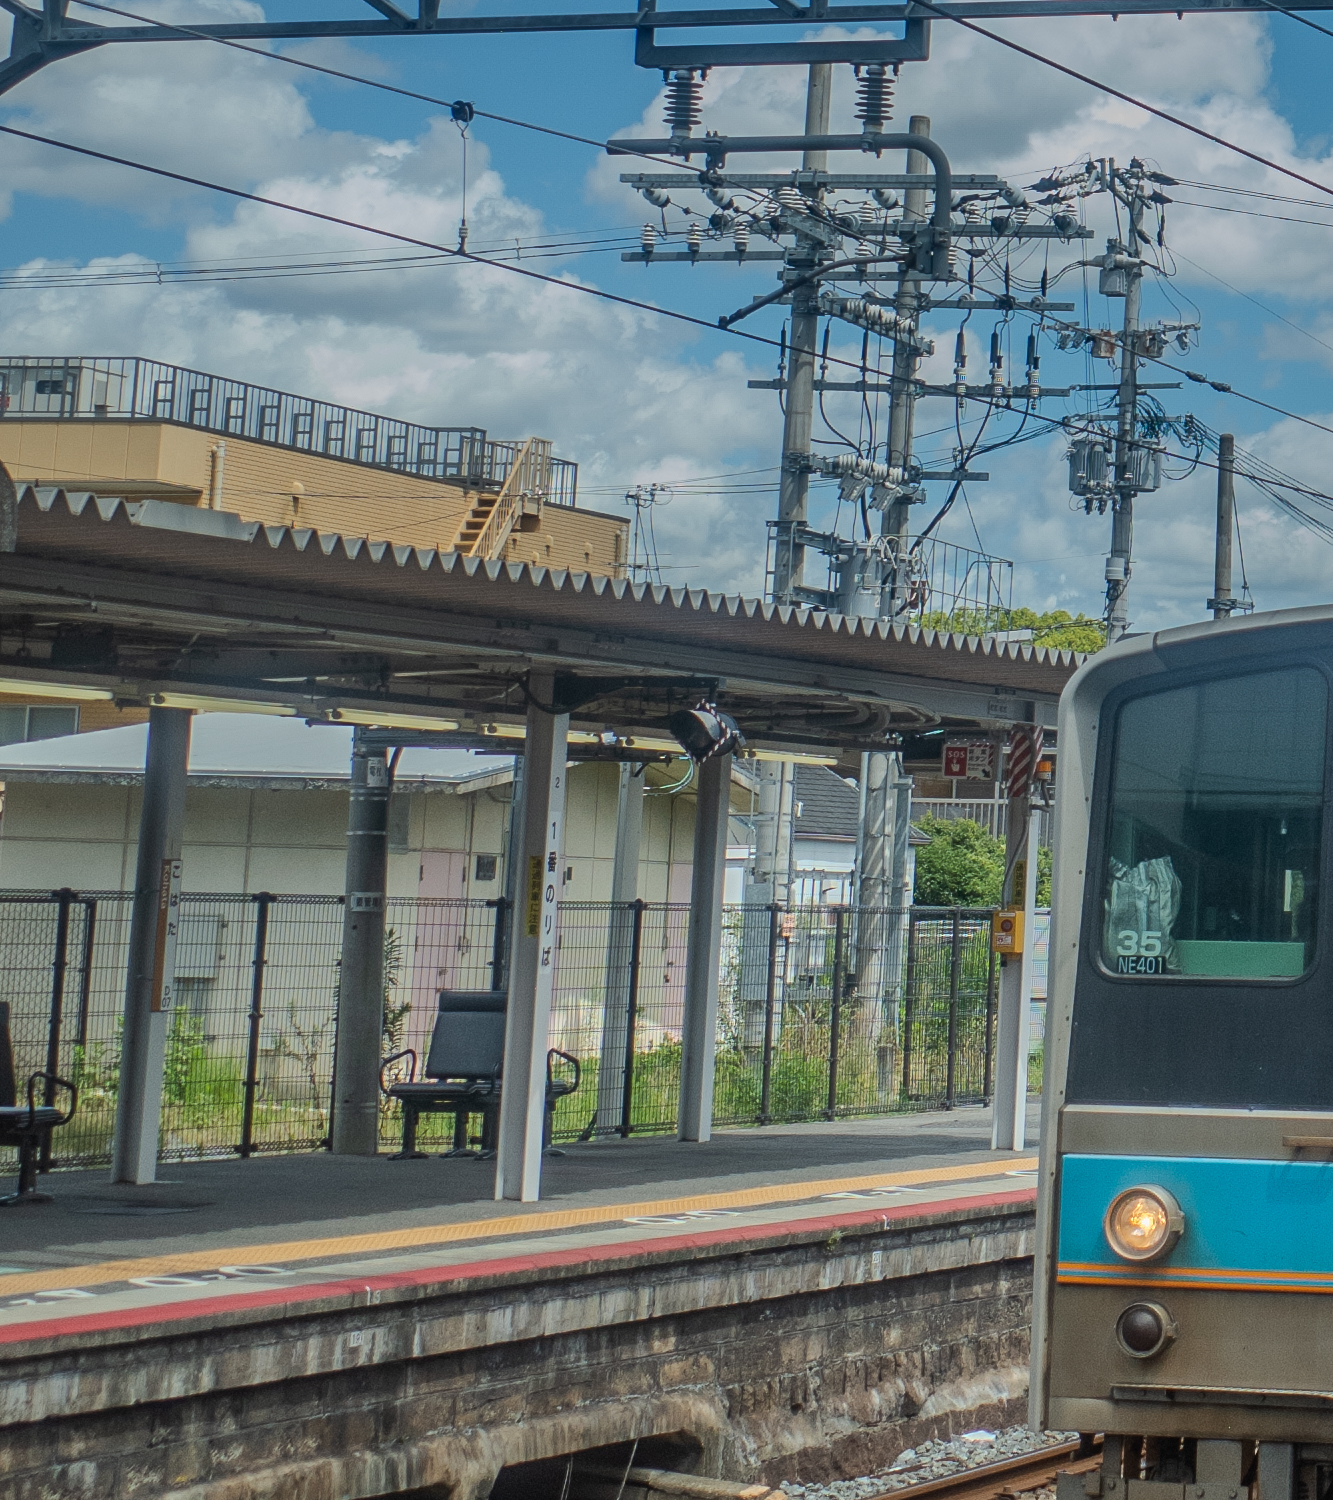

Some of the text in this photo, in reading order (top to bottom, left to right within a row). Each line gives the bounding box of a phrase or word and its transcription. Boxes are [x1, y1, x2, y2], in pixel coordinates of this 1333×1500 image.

[947, 750, 966, 758] SOS
[1116, 930, 1162, 957] 35
[1118, 956, 1163, 974] NE401
